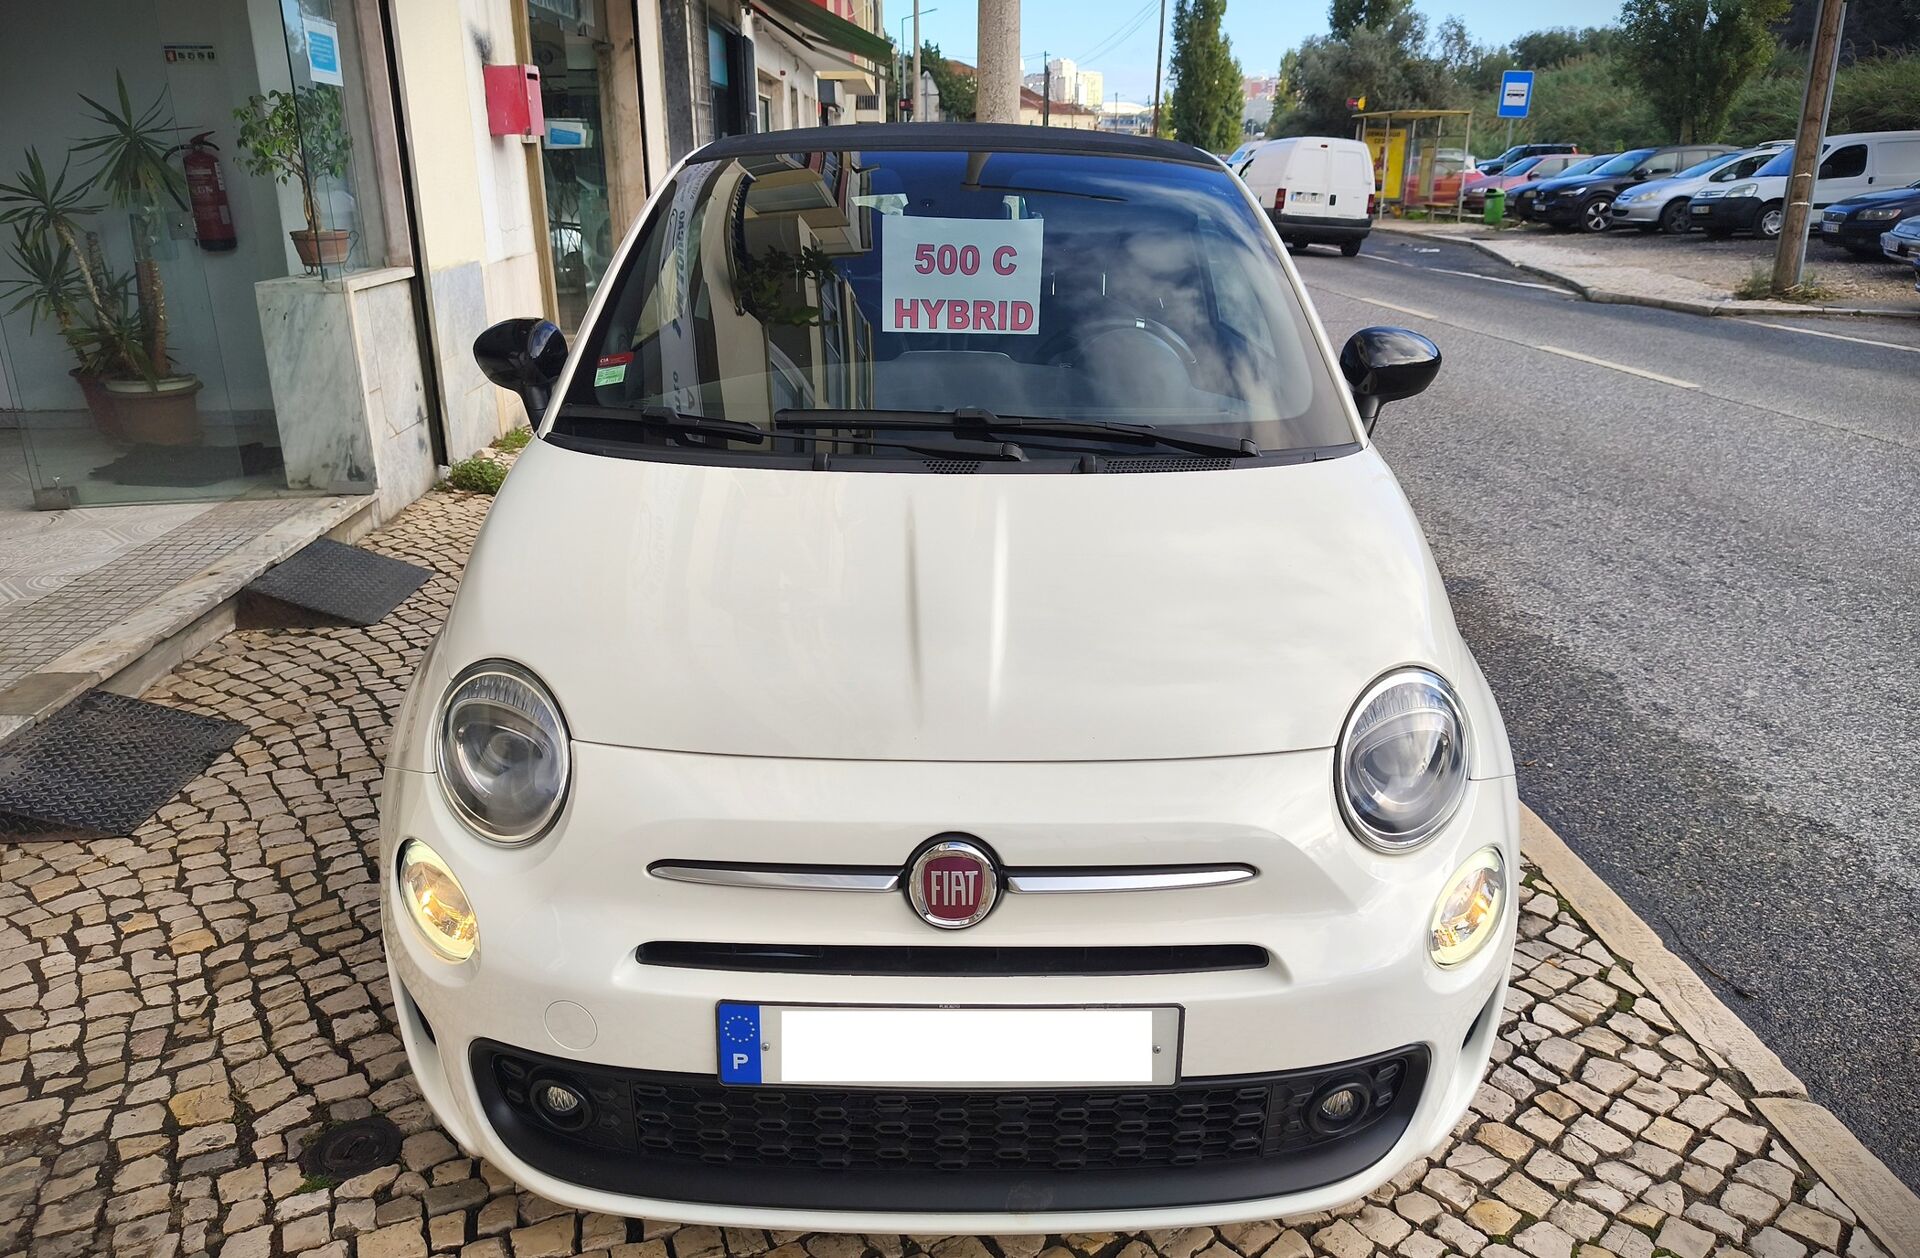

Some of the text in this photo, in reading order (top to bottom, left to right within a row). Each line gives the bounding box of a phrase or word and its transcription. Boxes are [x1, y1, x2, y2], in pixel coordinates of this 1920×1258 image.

[914, 244, 1018, 276] 500 C
[894, 298, 1034, 331] HYBRID
[930, 870, 979, 906] FIAT
[733, 1053, 749, 1070] P
